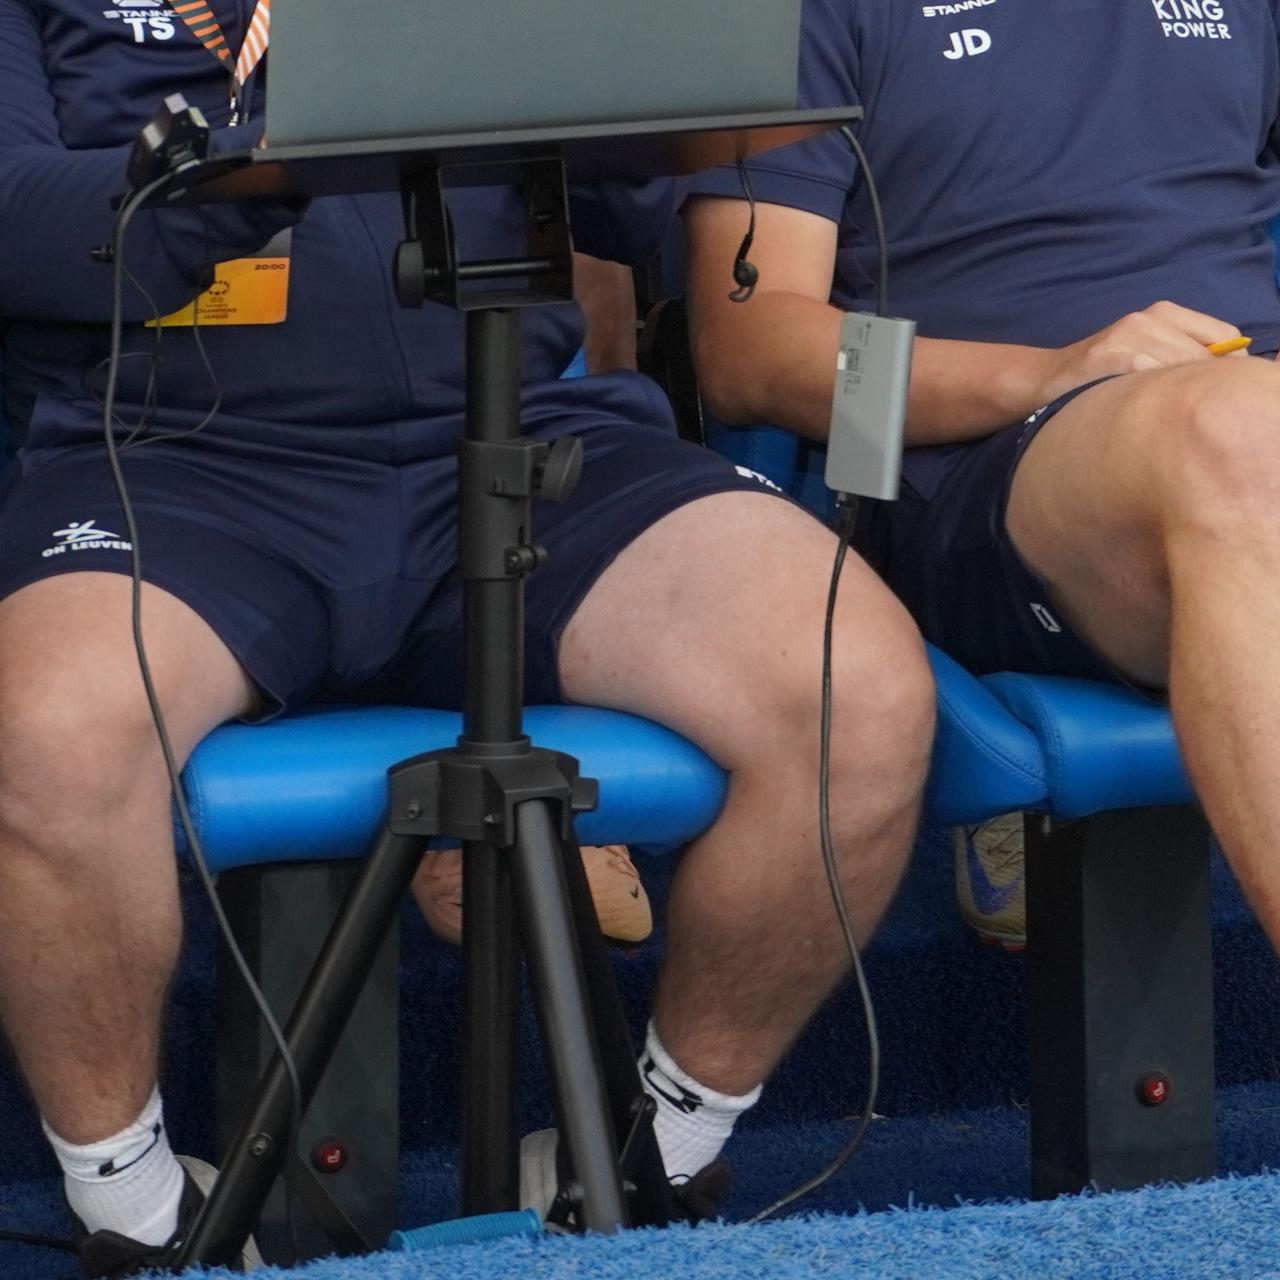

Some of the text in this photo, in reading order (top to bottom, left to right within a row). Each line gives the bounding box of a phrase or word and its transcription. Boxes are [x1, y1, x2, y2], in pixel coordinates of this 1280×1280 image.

[123, 17, 176, 43] TS
[1161, 22, 1232, 39] POWER
[943, 28, 992, 60] JD
[71, 540, 132, 551] LEUVEN
